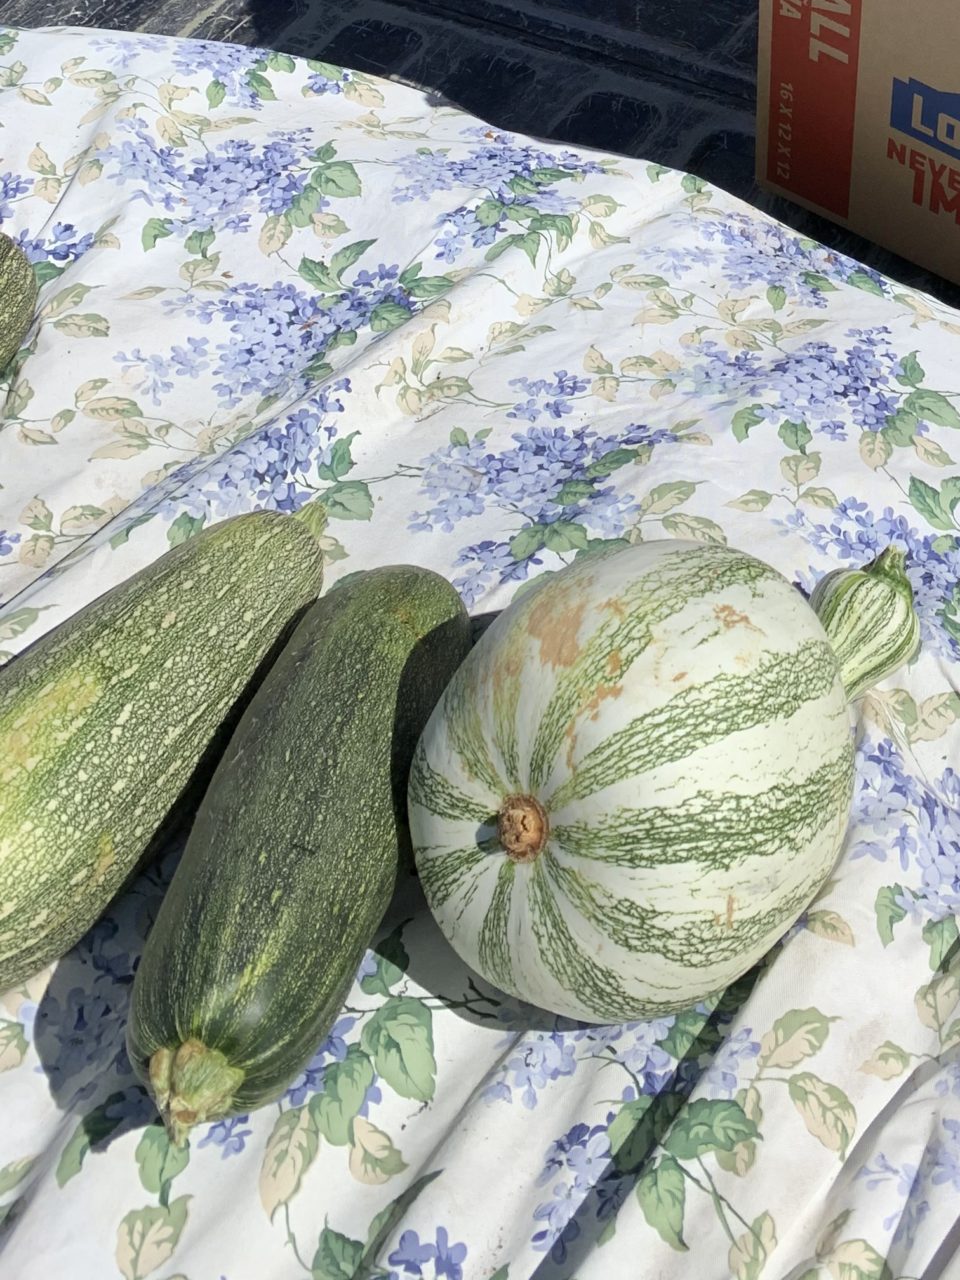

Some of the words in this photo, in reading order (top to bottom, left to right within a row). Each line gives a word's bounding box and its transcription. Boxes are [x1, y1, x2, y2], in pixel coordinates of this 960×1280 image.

[778, 81, 794, 102] 16
[777, 122, 793, 141] 12
[776, 160, 791, 181] 12
